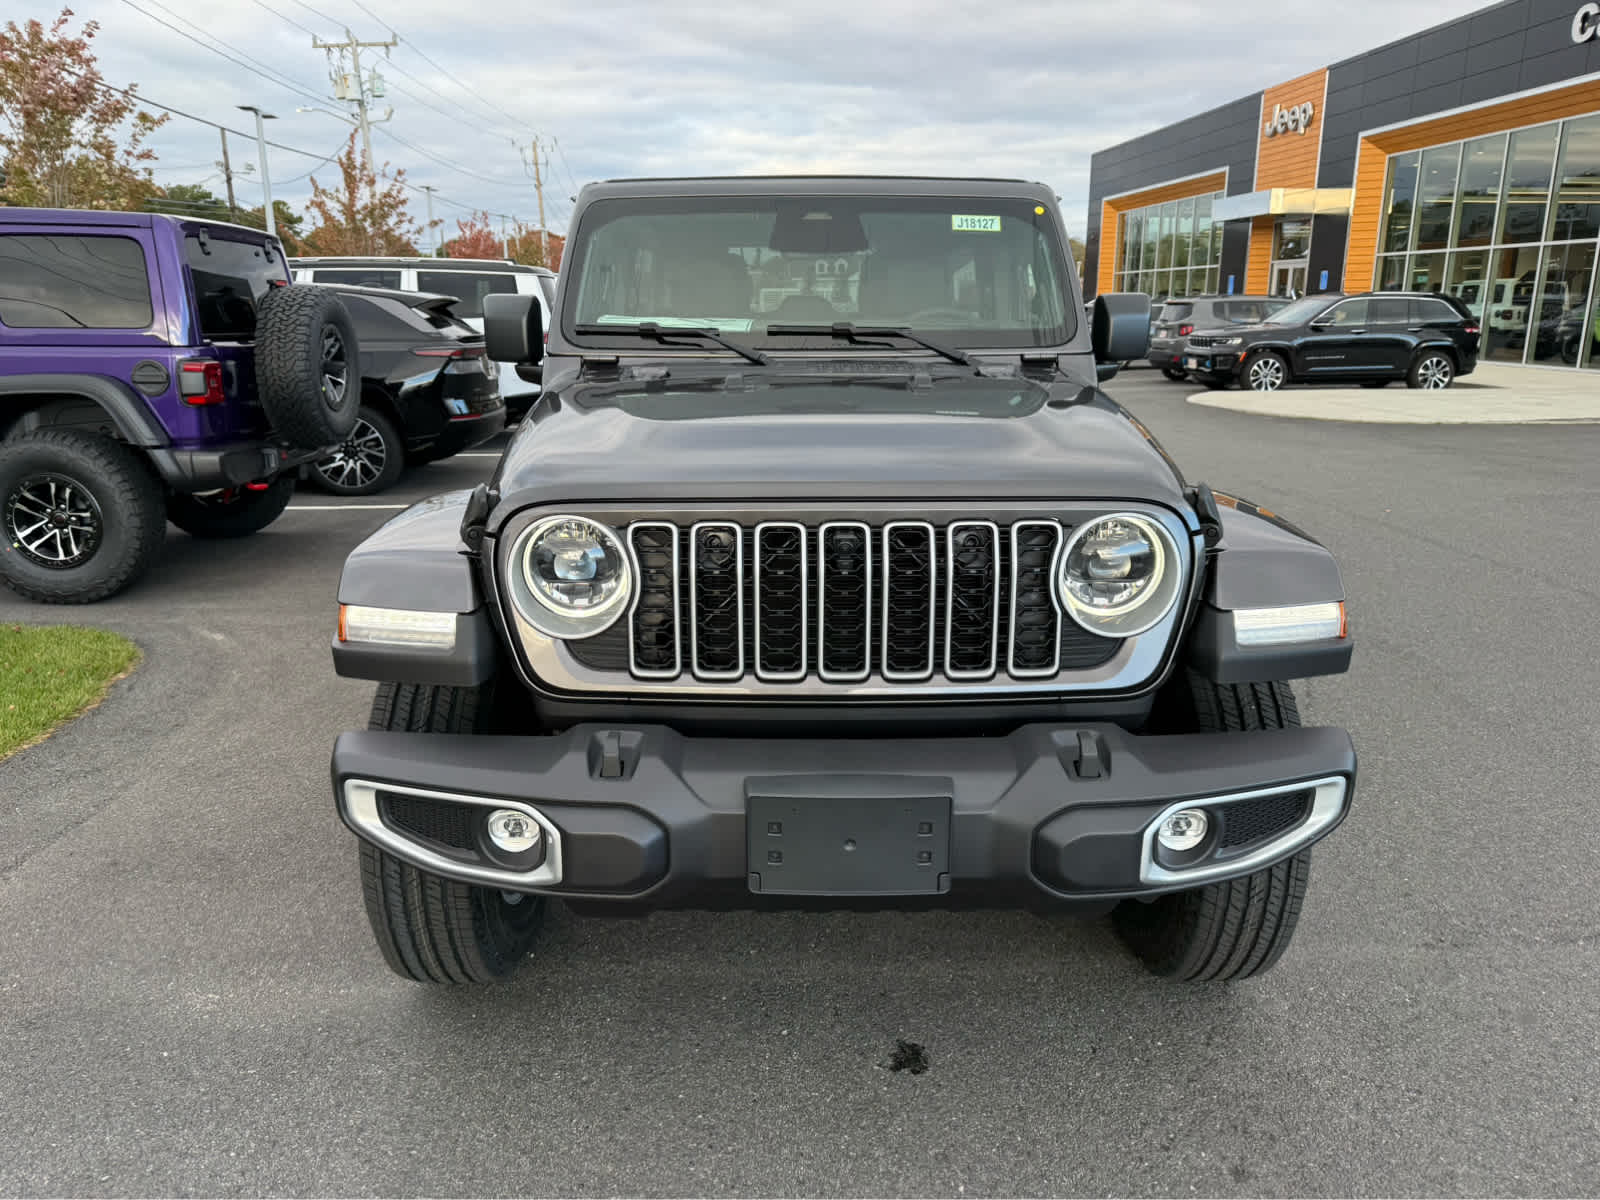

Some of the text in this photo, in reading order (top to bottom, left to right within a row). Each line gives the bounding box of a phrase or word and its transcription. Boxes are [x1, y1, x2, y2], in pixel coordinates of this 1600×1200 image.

[1571, 2, 1600, 43] C
[1264, 101, 1314, 138] Jeep
[957, 217, 994, 229] J18127
